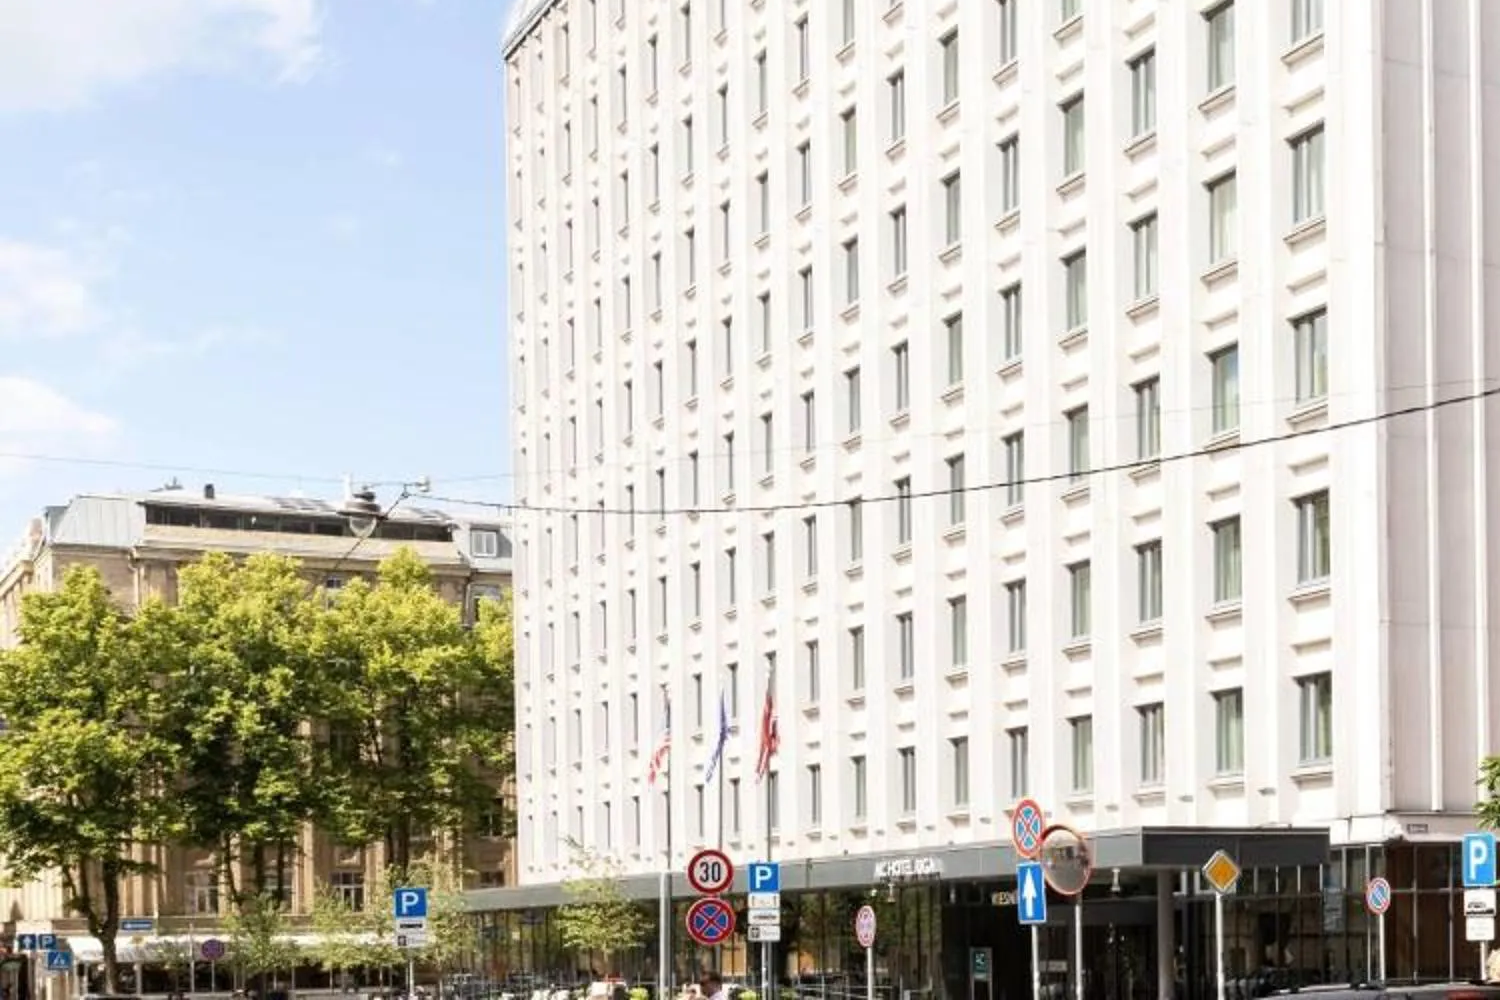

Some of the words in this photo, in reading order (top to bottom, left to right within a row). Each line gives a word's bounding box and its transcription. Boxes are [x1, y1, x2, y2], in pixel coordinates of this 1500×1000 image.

[1469, 838, 1488, 880] P
[700, 861, 721, 882] 30
[755, 865, 772, 888] P
[402, 891, 419, 914] P
